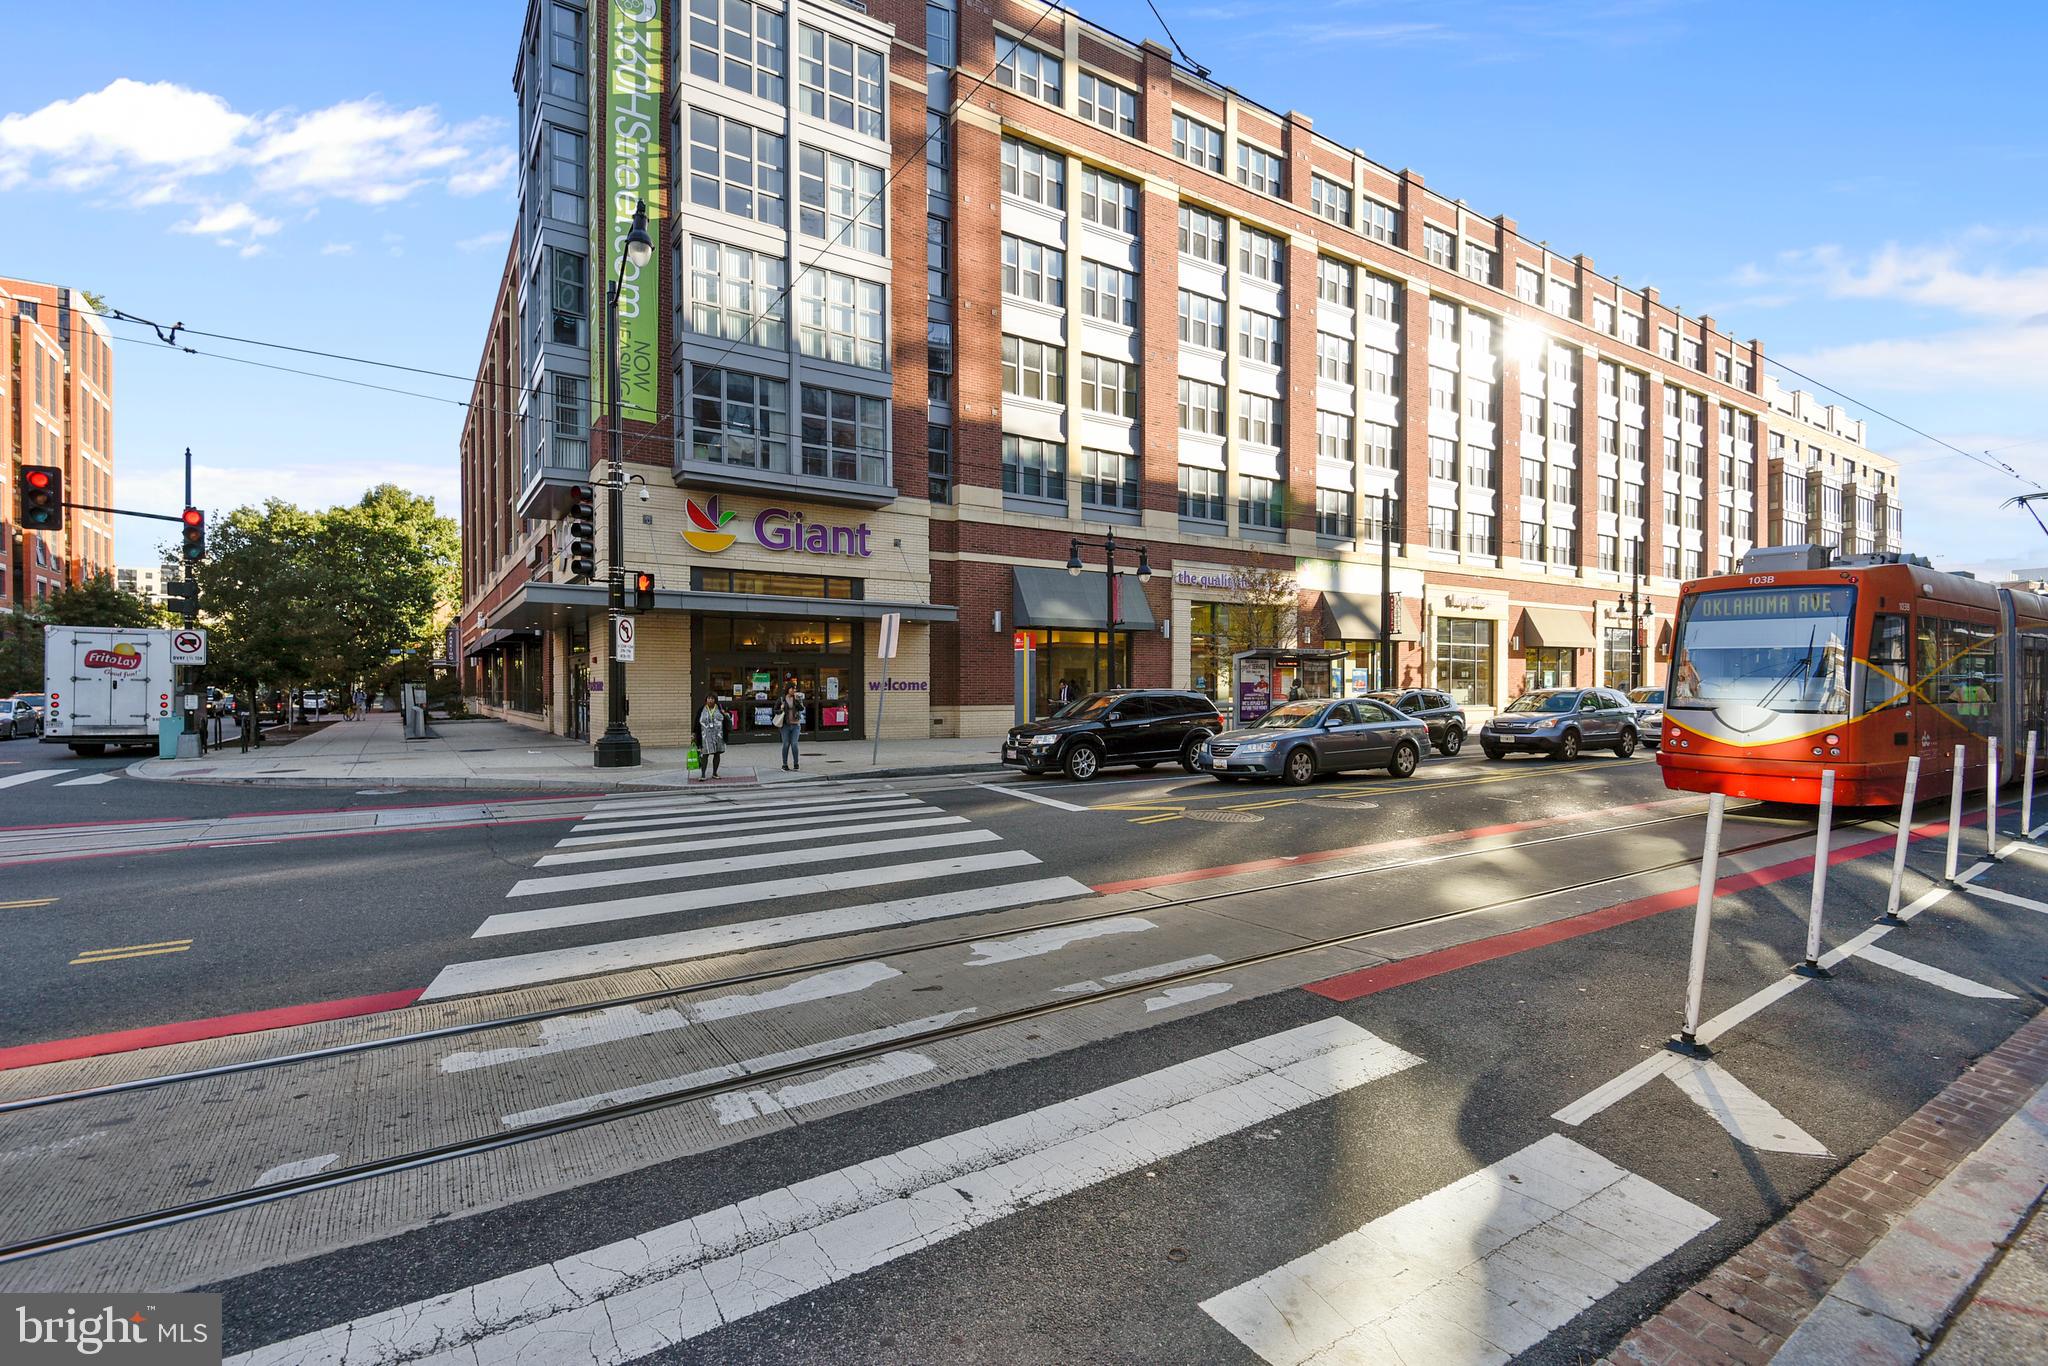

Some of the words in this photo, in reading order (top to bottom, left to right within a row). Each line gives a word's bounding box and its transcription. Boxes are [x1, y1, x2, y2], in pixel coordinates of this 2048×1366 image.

[633, 340, 650, 392] NOW
[754, 507, 872, 557] Giant
[1178, 571, 1197, 585] the
[1702, 595, 1789, 617] OKLAHOMA
[1799, 592, 1831, 613] AVE
